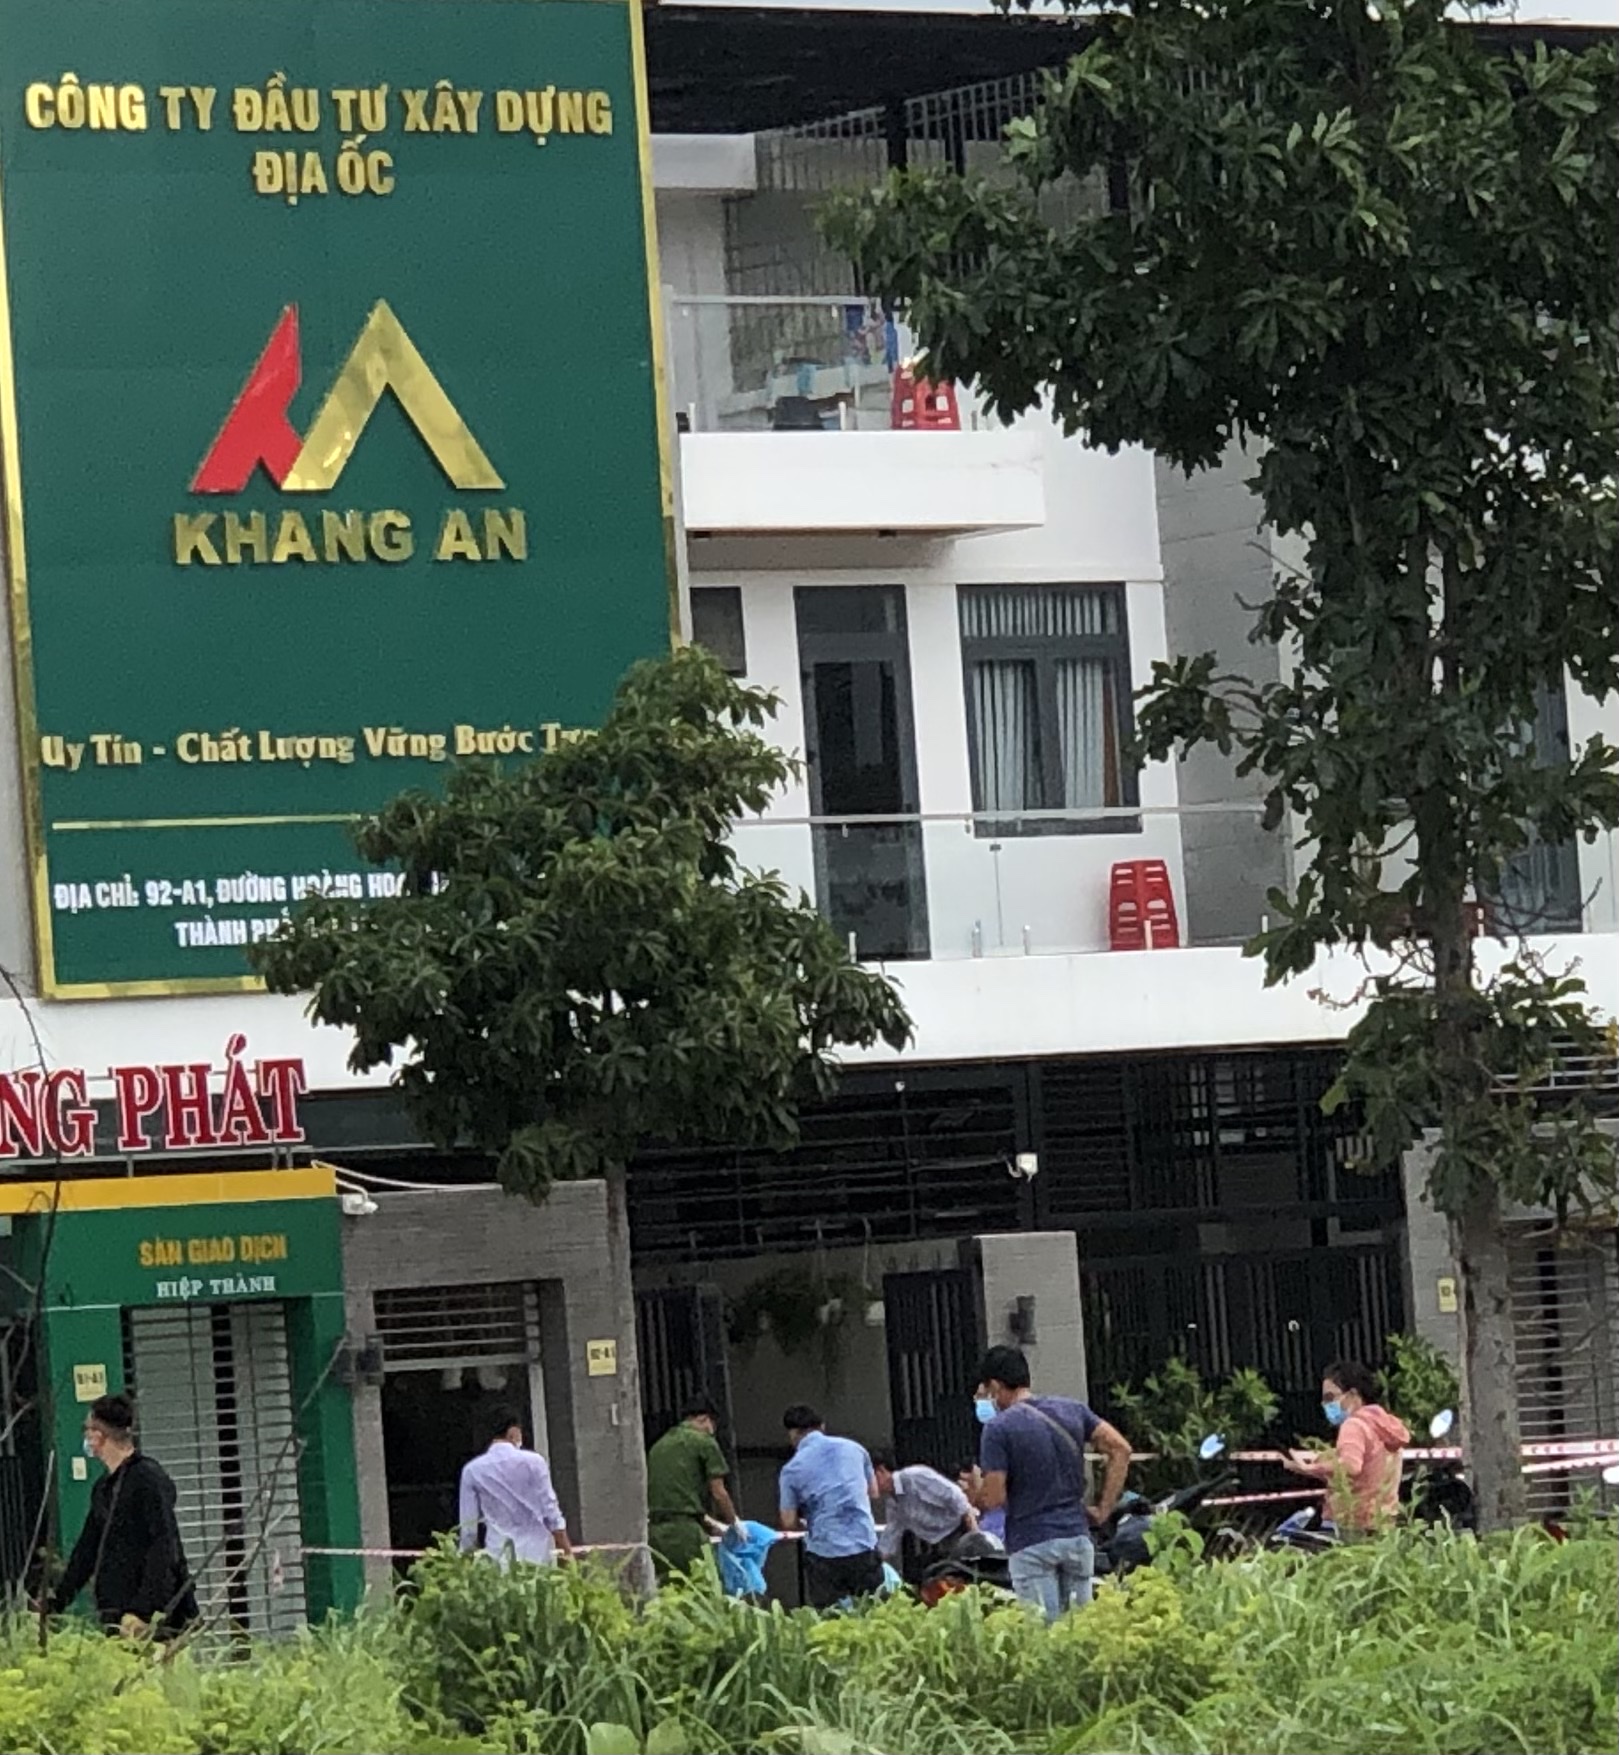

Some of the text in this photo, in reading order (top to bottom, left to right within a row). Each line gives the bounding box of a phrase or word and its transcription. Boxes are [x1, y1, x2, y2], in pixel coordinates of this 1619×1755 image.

[26, 71, 613, 145] CÔNG TY ĐẦU TƯ XÂY DỰNG
[253, 134, 395, 205] ĐỊA ỐC
[174, 508, 528, 565] KHANG AN
[41, 735, 84, 771] Uy
[90, 734, 142, 764] Tín
[152, 746, 166, 755] -
[177, 727, 253, 763] Chất
[259, 730, 355, 768] Lượng
[363, 727, 447, 762] Vững
[454, 723, 534, 755] Bước
[54, 883, 93, 914] ĐỊA
[95, 873, 140, 908] CHỈ:
[145, 879, 214, 908] 92-A1,
[216, 870, 287, 903] ĐƯỜNG
[175, 915, 247, 947] THÀNH
[109, 1032, 308, 1151] PHÁT
[188, 1236, 235, 1263] GIAO
[240, 1234, 287, 1265] DỊCH
[156, 1272, 276, 1300] HIỆP THÀNH
